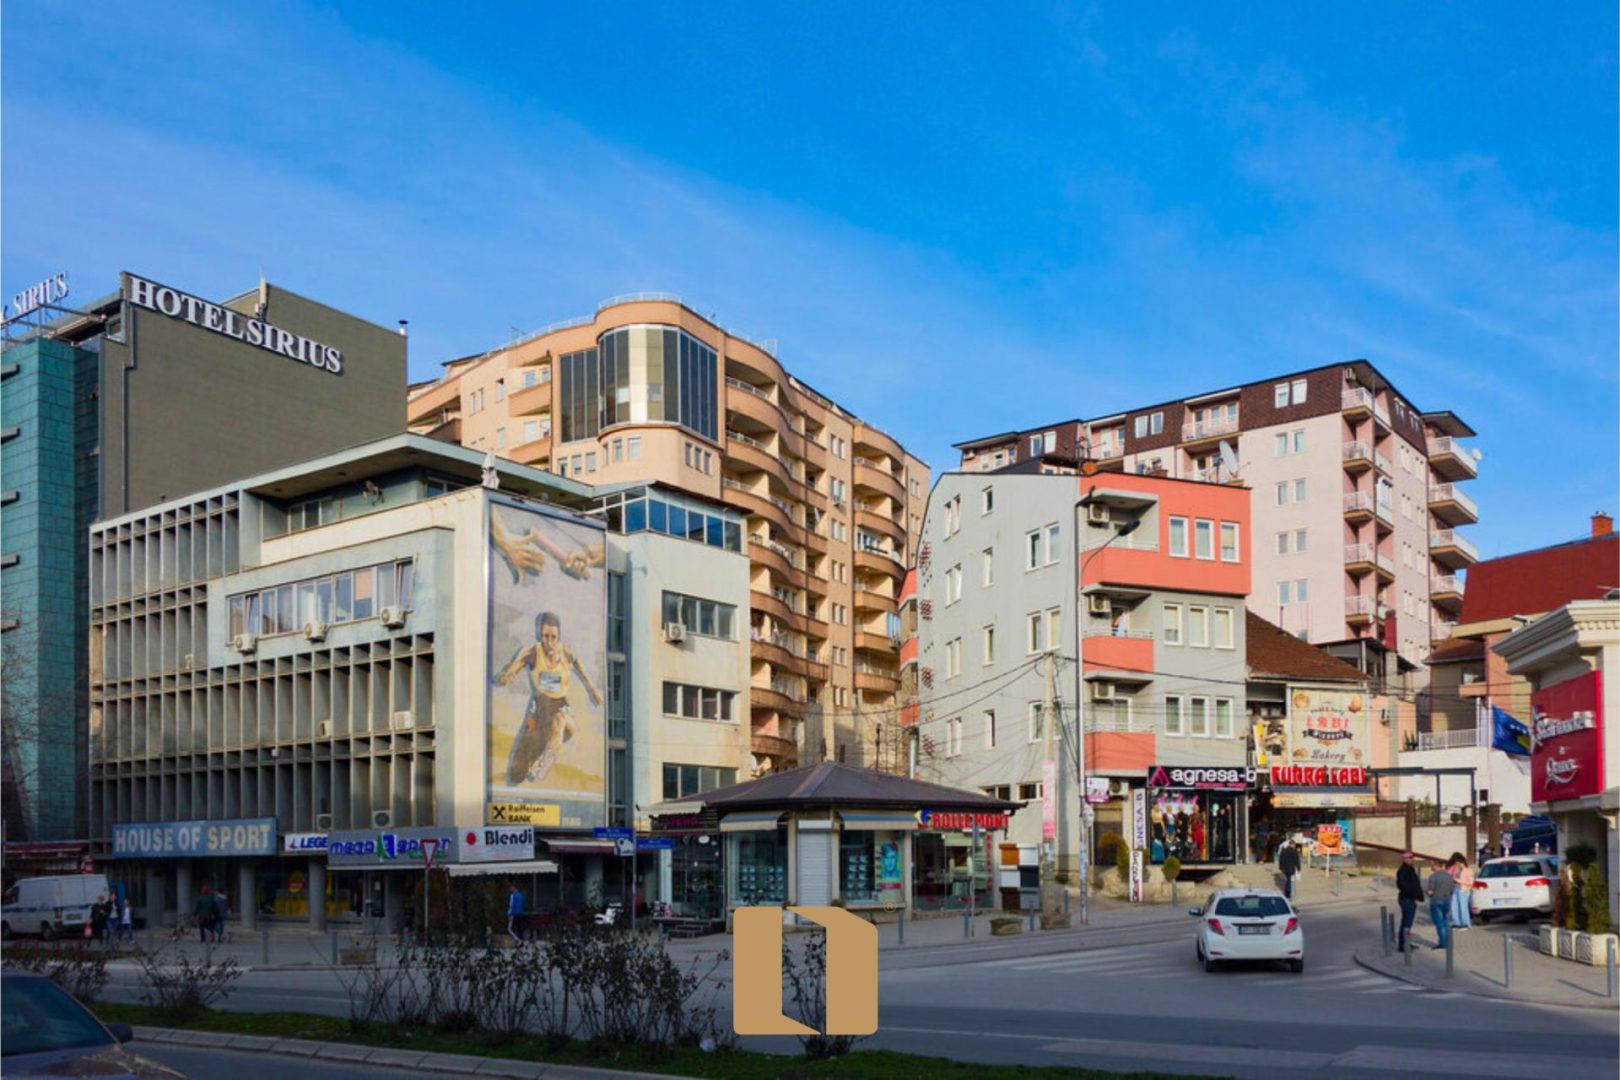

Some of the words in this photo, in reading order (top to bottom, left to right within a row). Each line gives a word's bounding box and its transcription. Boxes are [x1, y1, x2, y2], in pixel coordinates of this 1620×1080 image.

[130, 276, 244, 339] HOTEL
[245, 317, 342, 374] SIRIUS
[1170, 767, 1256, 785] agnesa-b
[1270, 766, 1327, 786] FURRA
[1328, 766, 1367, 786] LABI
[508, 804, 545, 813] Raiffeisen
[508, 814, 531, 824] BANK
[115, 827, 174, 853] HOUSE
[177, 826, 201, 851] OF
[207, 823, 272, 850] SPORT
[484, 829, 533, 846] Blendi
